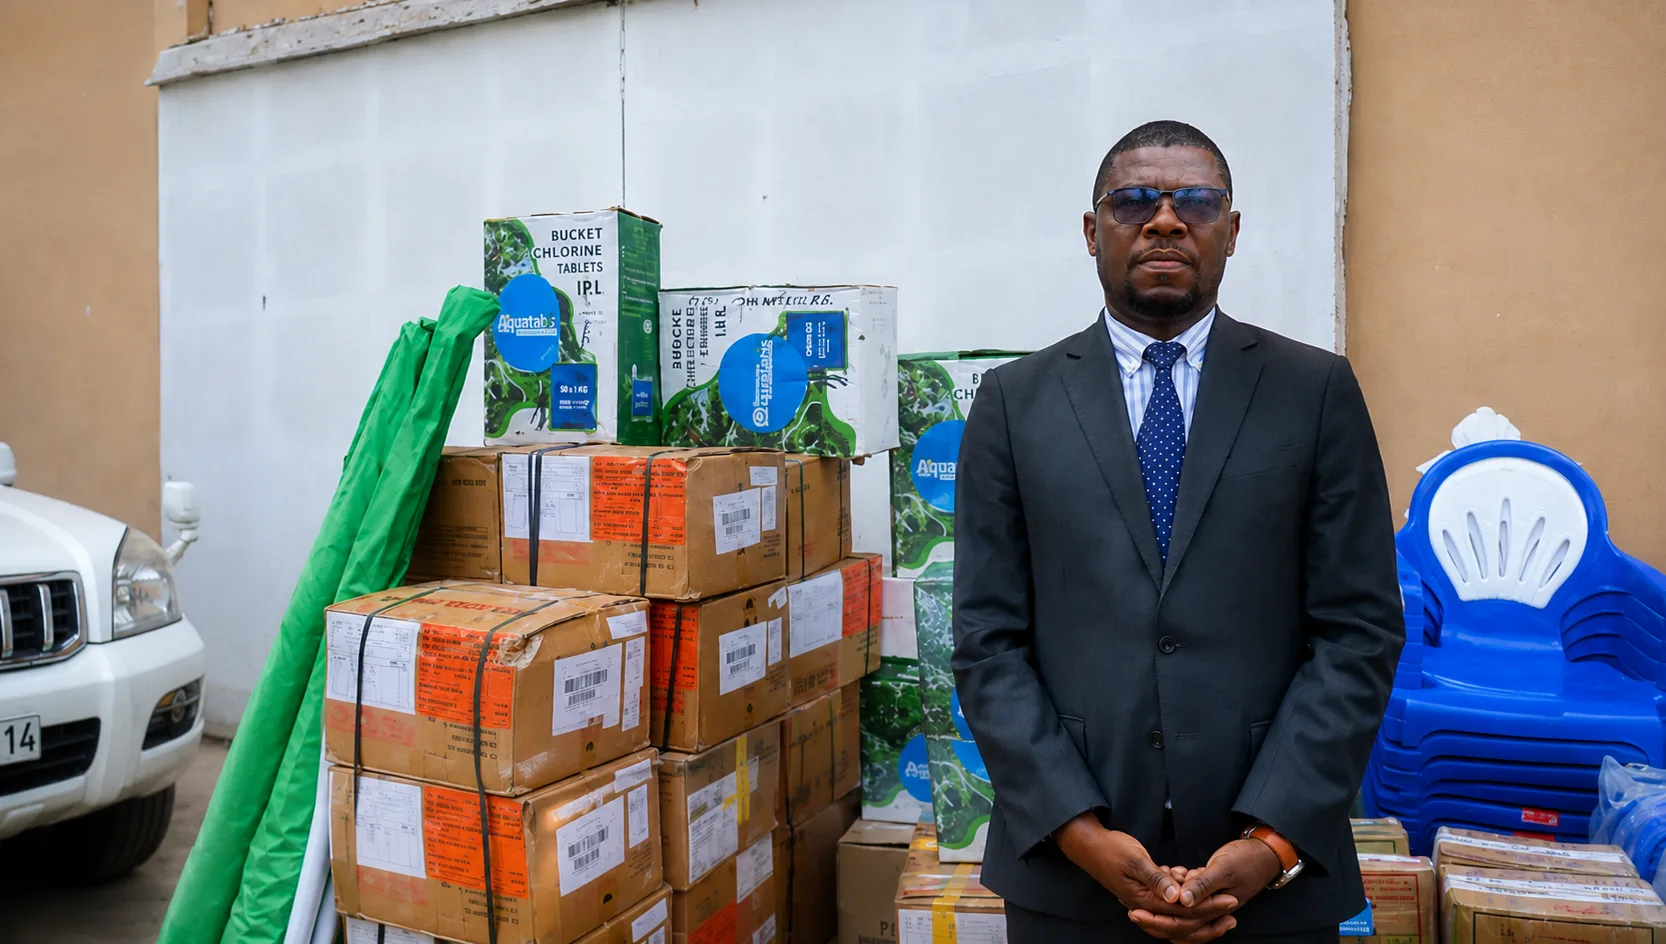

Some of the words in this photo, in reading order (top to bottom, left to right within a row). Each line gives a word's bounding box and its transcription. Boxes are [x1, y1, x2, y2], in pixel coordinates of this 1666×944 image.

[551, 227, 603, 241] BUCKET
[533, 245, 602, 259] CHLORINE
[557, 261, 603, 274] TABLETS
[497, 313, 556, 334] Aquatabs
[953, 389, 974, 400] CH
[916, 459, 957, 478] Aqua
[4, 722, 36, 755] 14
